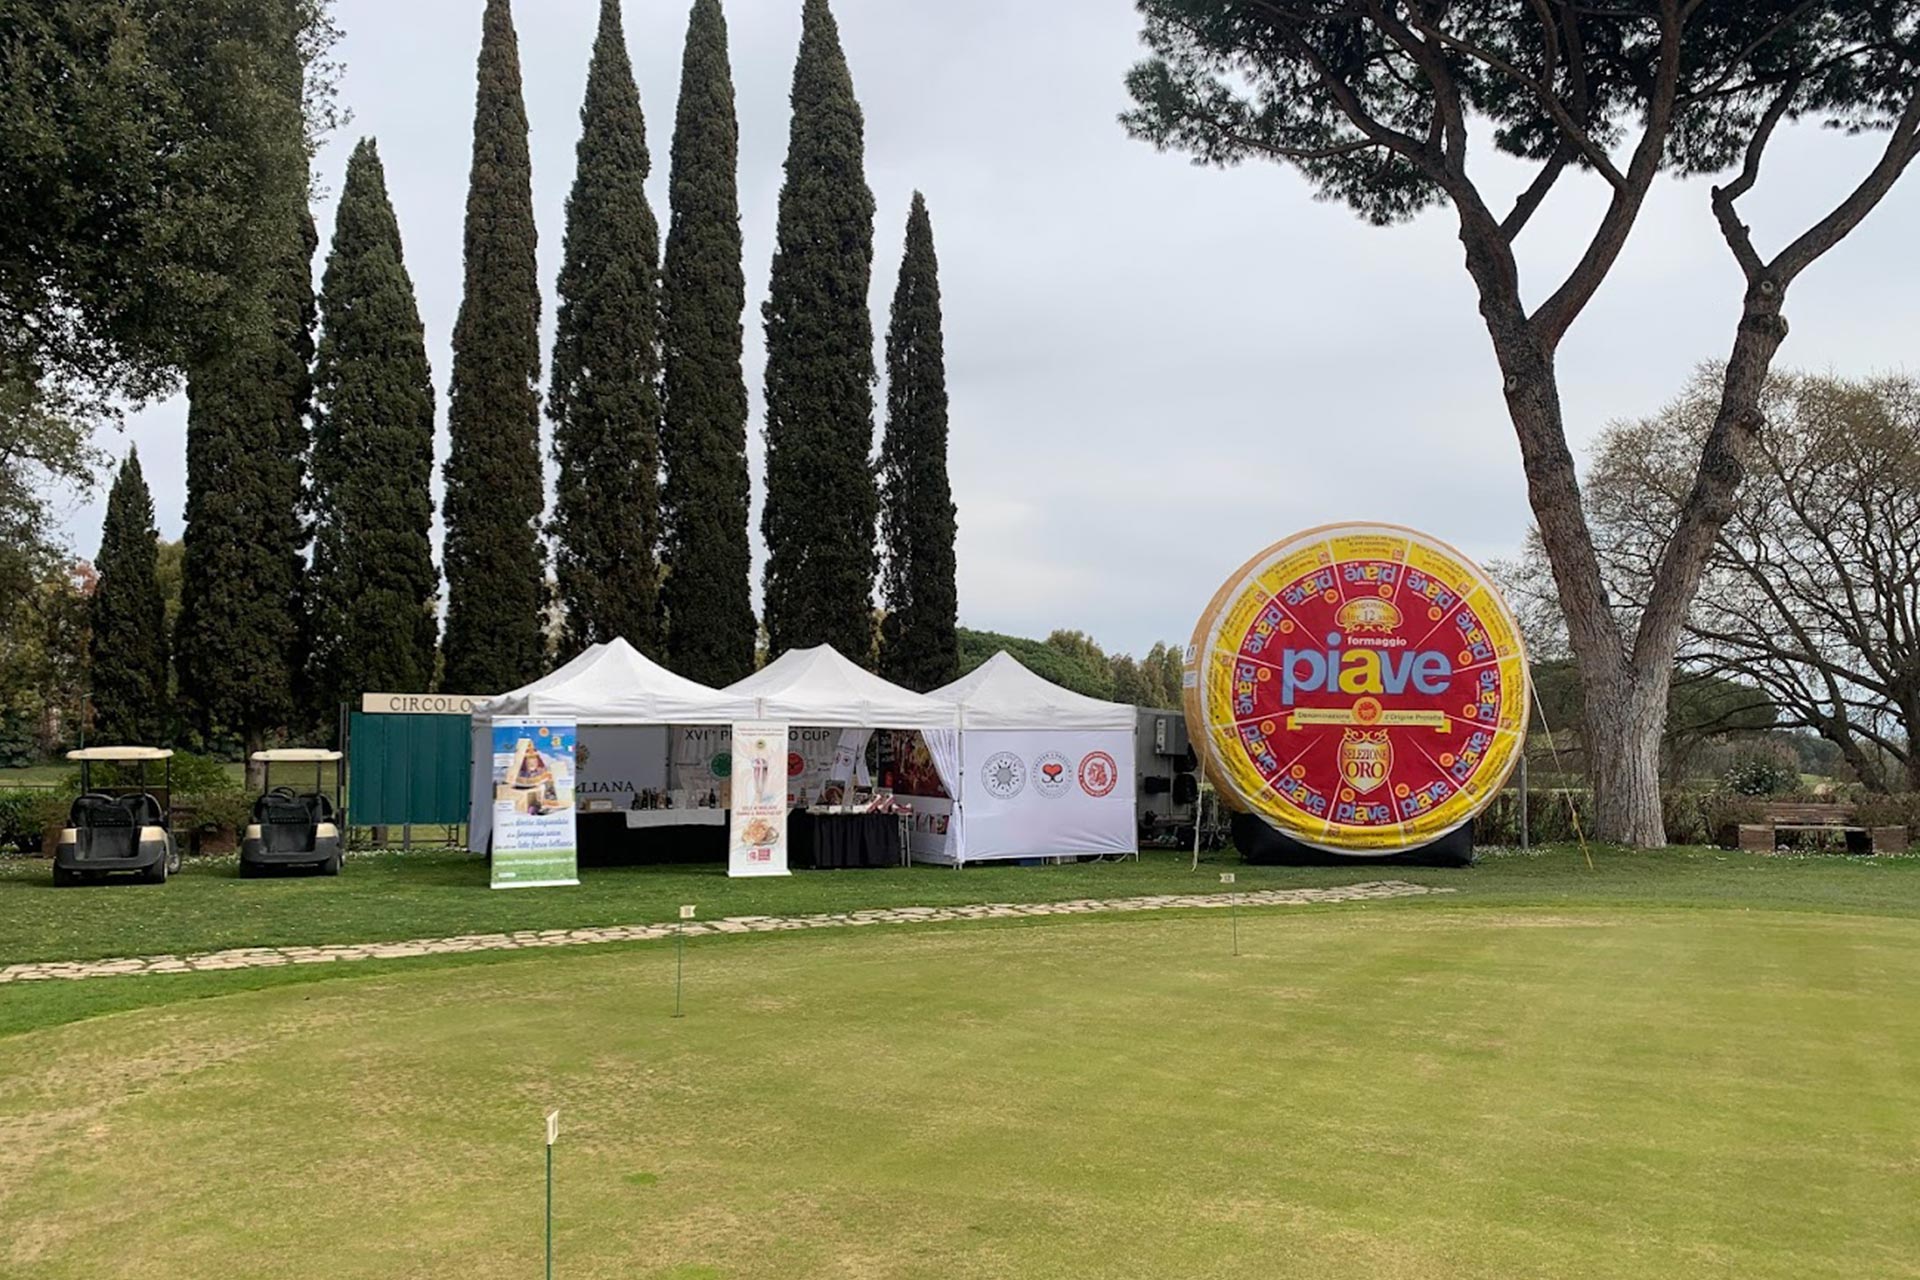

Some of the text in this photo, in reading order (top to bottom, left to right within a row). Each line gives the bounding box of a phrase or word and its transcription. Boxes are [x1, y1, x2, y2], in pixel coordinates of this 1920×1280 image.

[1285, 569, 1333, 606] piave
[1344, 565, 1397, 585] piave
[1407, 574, 1456, 610] piave
[1248, 605, 1283, 653] piave
[1363, 609, 1376, 620] 12
[1347, 636, 1407, 647] formaggio
[1456, 611, 1493, 659] piave
[1281, 632, 1451, 705] piave
[389, 696, 473, 712] CIRCOLO
[1239, 663, 1259, 714] piave
[1476, 670, 1496, 722] piave
[802, 730, 831, 741] CUP
[1242, 725, 1277, 772] piave
[1343, 749, 1387, 760] SELEZIONE
[1346, 761, 1385, 778] ORO
[1451, 732, 1487, 781] piave
[1276, 775, 1326, 812] piave
[1336, 801, 1390, 821] piave
[1401, 781, 1449, 817] piave
